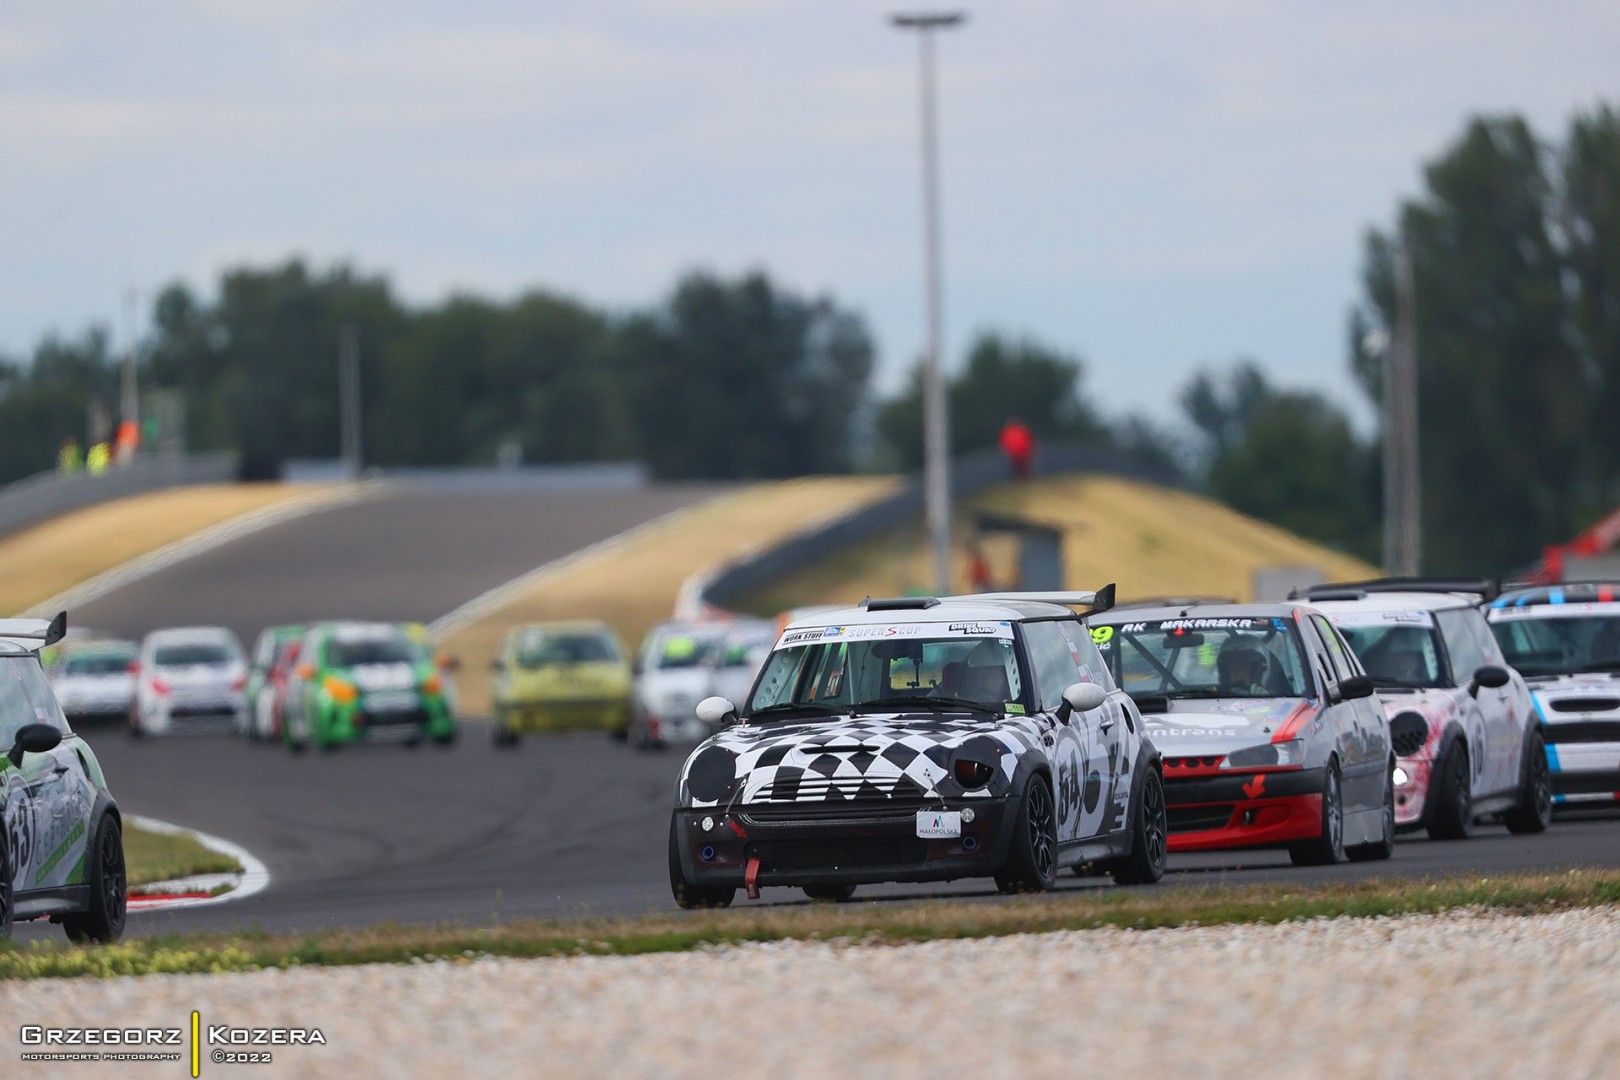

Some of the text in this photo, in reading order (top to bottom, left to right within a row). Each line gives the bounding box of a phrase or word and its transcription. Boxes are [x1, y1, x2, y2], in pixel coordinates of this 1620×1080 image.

[849, 627, 884, 638] SUPER
[885, 626, 898, 637] S
[898, 625, 921, 635] CUP
[949, 623, 979, 631] DRIVE
[1121, 619, 1252, 633] AK MAKARSKA
[803, 632, 823, 640] STUFF
[1089, 626, 1114, 644] 9
[1145, 727, 1236, 737] ntrans
